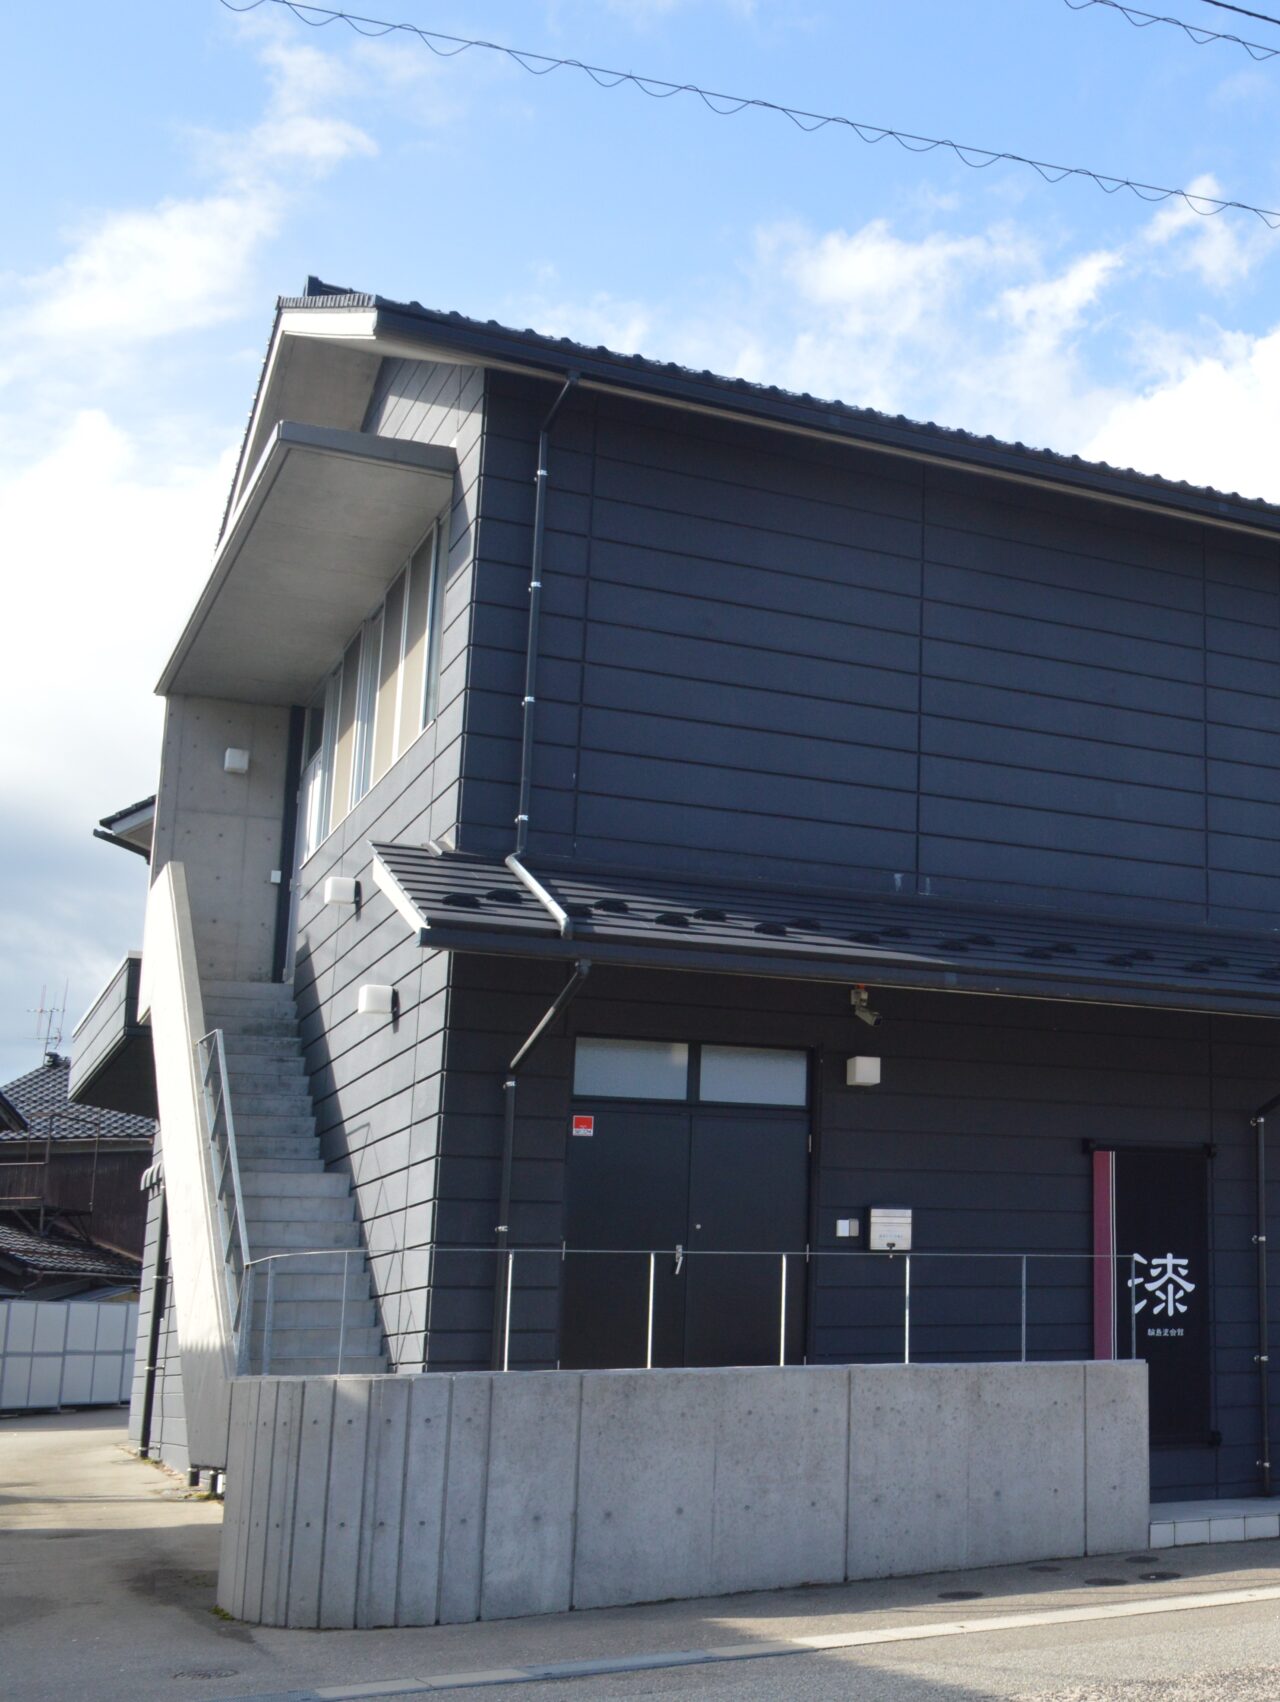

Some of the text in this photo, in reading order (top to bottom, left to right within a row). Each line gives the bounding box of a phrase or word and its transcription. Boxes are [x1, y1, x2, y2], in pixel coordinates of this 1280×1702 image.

[1127, 1253, 1195, 1317] 漆
[1147, 1327, 1184, 1337] 輪島塗会館
